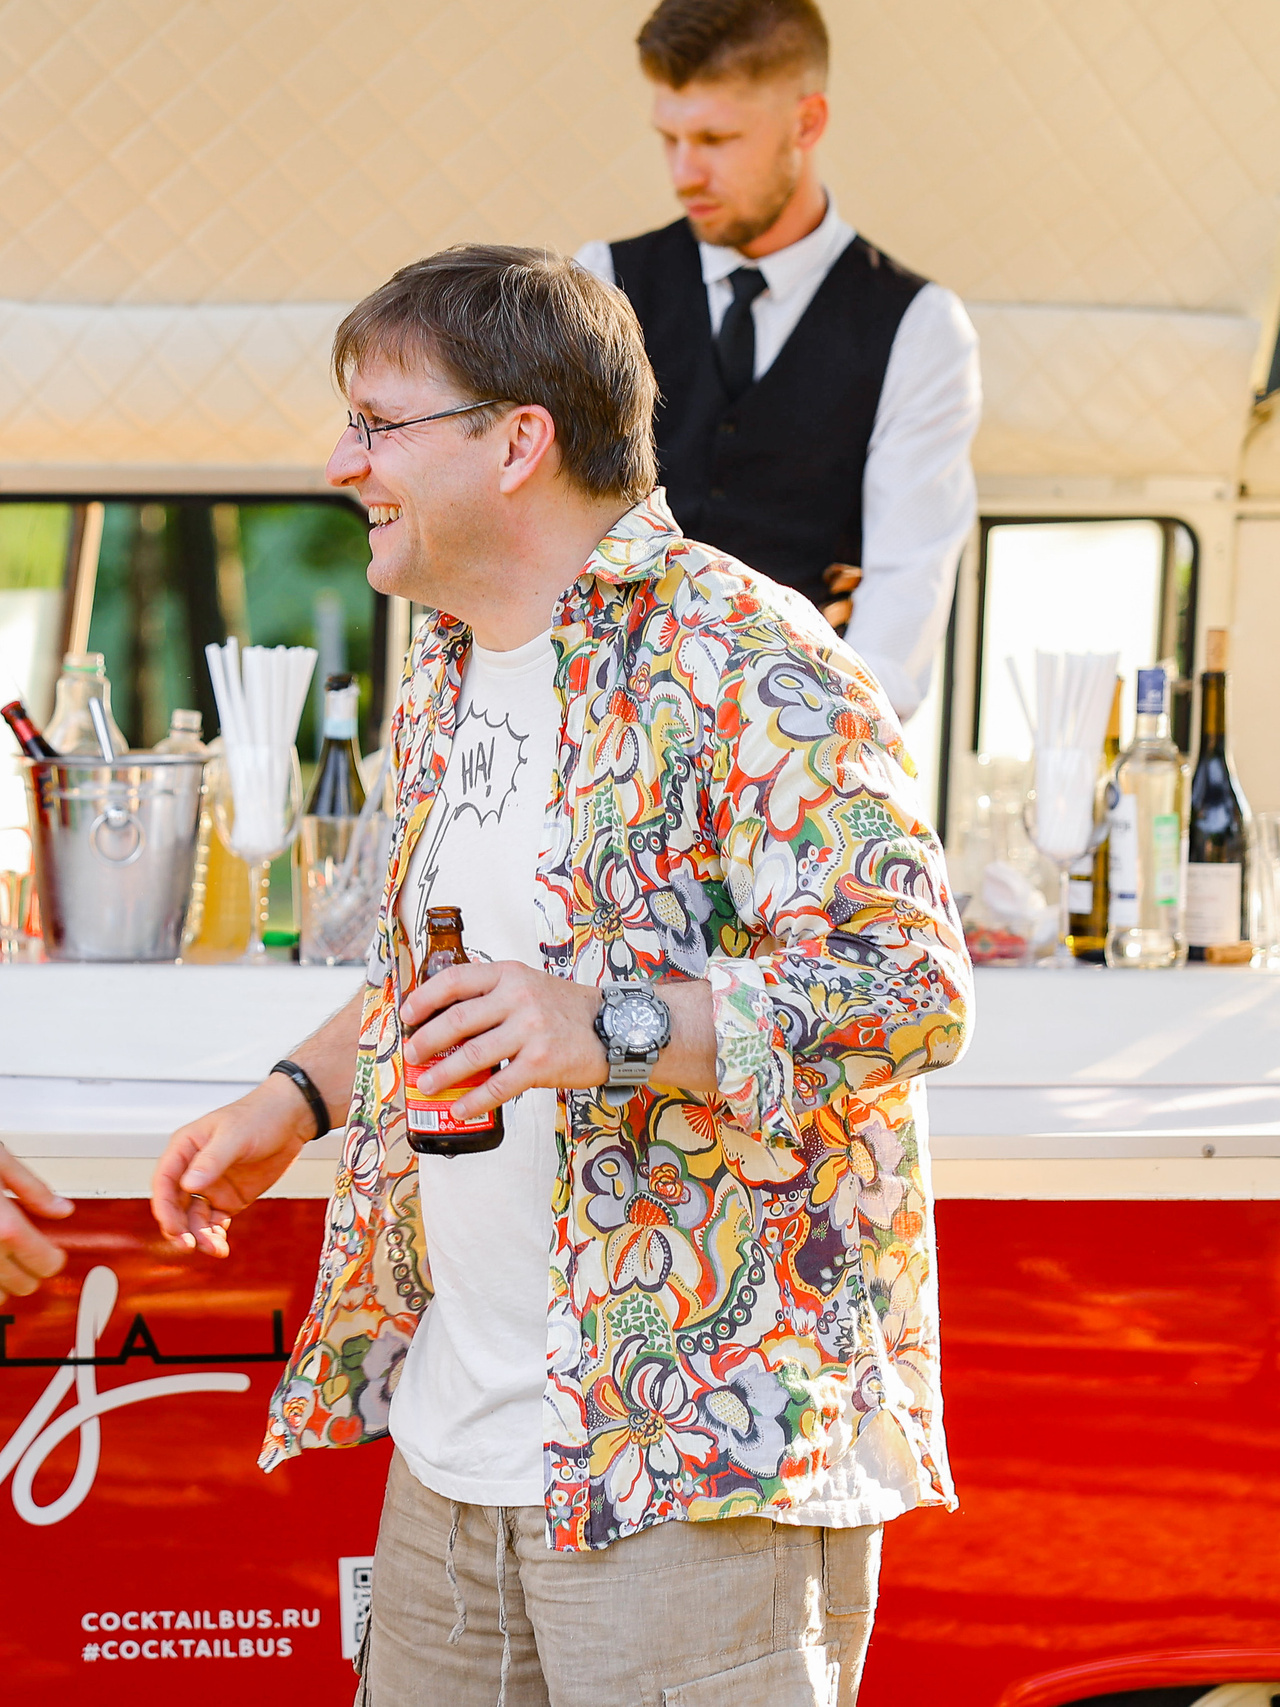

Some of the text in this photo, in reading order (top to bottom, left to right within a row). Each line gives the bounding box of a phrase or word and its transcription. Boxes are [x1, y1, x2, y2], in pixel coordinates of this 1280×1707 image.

[461, 736, 495, 798] HA!
[81, 1608, 320, 1631] COCKTAILBUS.RU
[81, 1637, 293, 1662] #COCKTAILBUS
